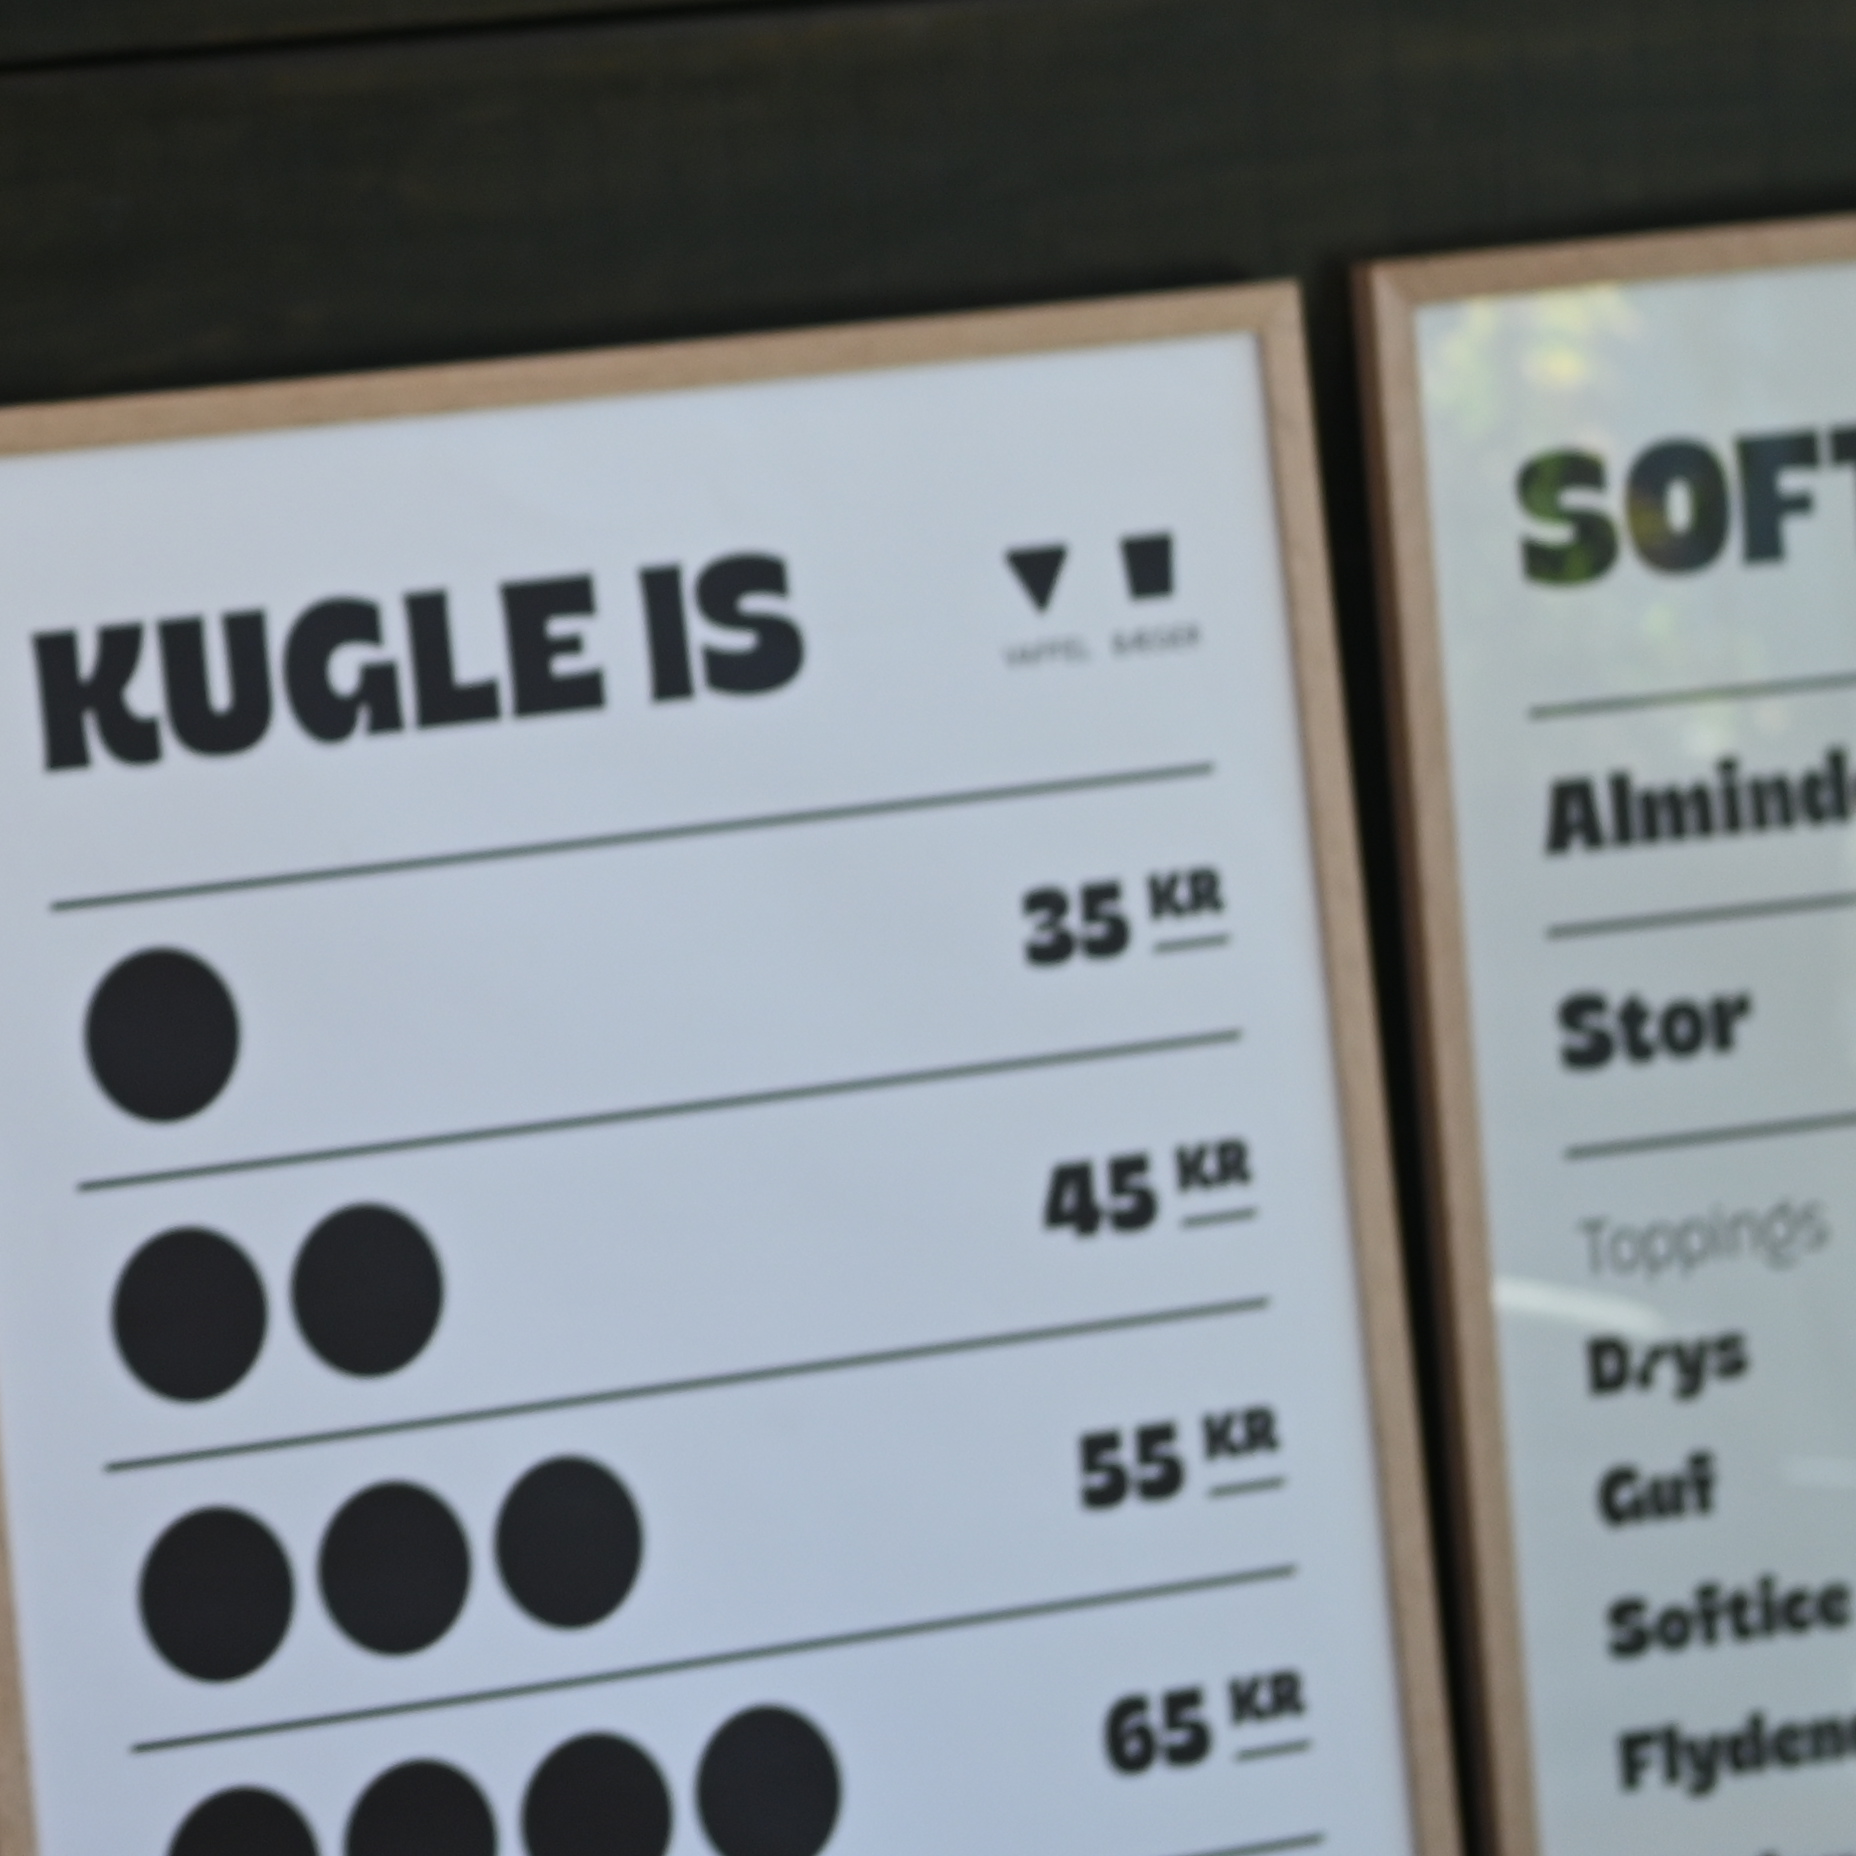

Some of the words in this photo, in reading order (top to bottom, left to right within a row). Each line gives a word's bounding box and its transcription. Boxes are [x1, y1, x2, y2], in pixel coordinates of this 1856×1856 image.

[29, 571, 608, 774] KUGLE
[636, 550, 807, 706] IS
[1544, 744, 1856, 858] Almind
[1020, 878, 1132, 968] 35
[1146, 866, 1226, 922] KR
[1556, 990, 1753, 1072] Stor
[1041, 1151, 1160, 1239] 45
[1173, 1138, 1254, 1193] KR
[1577, 1197, 1833, 1282] Toppings
[1585, 1330, 1750, 1402] Drys
[1077, 1420, 1187, 1512] 55
[1201, 1405, 1281, 1461] KR
[1596, 1448, 1717, 1529] Guf
[1605, 1574, 1853, 1661] Softice
[1102, 1685, 1214, 1777] 65
[1227, 1669, 1307, 1726] KR
[1616, 1710, 1856, 1799] Flyden
